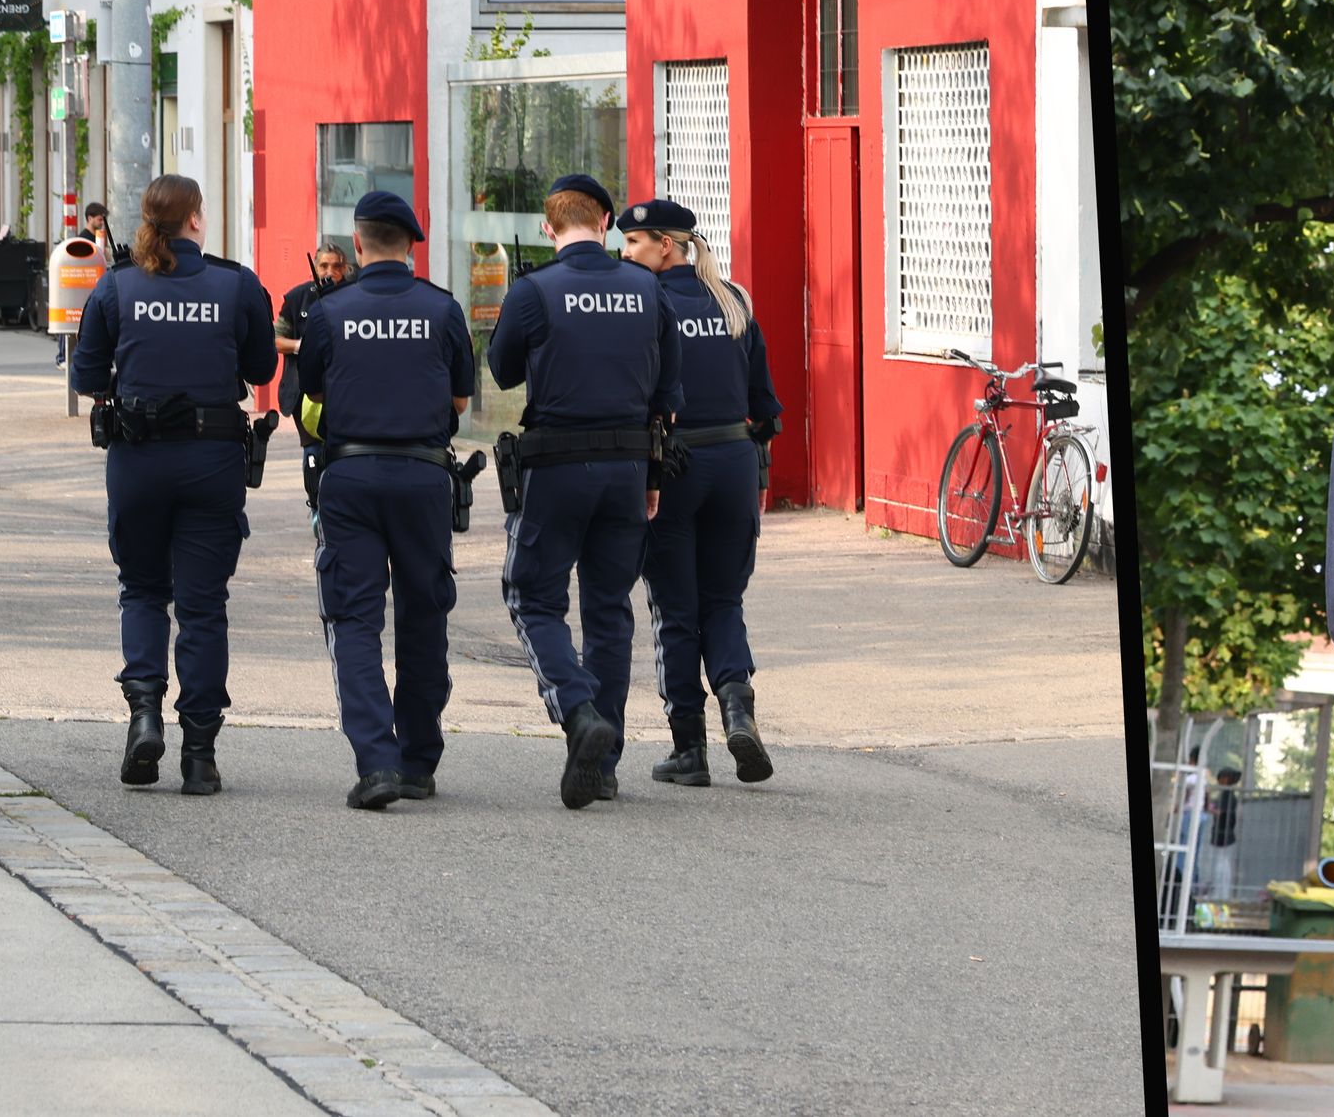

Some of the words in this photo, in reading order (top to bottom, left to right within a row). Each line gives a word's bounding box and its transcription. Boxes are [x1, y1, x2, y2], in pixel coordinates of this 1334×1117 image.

[134, 300, 219, 323] POLIZEI
[565, 293, 644, 313] POLIZEI
[344, 319, 430, 340] POLIZEI
[677, 317, 732, 338] OLIZ
